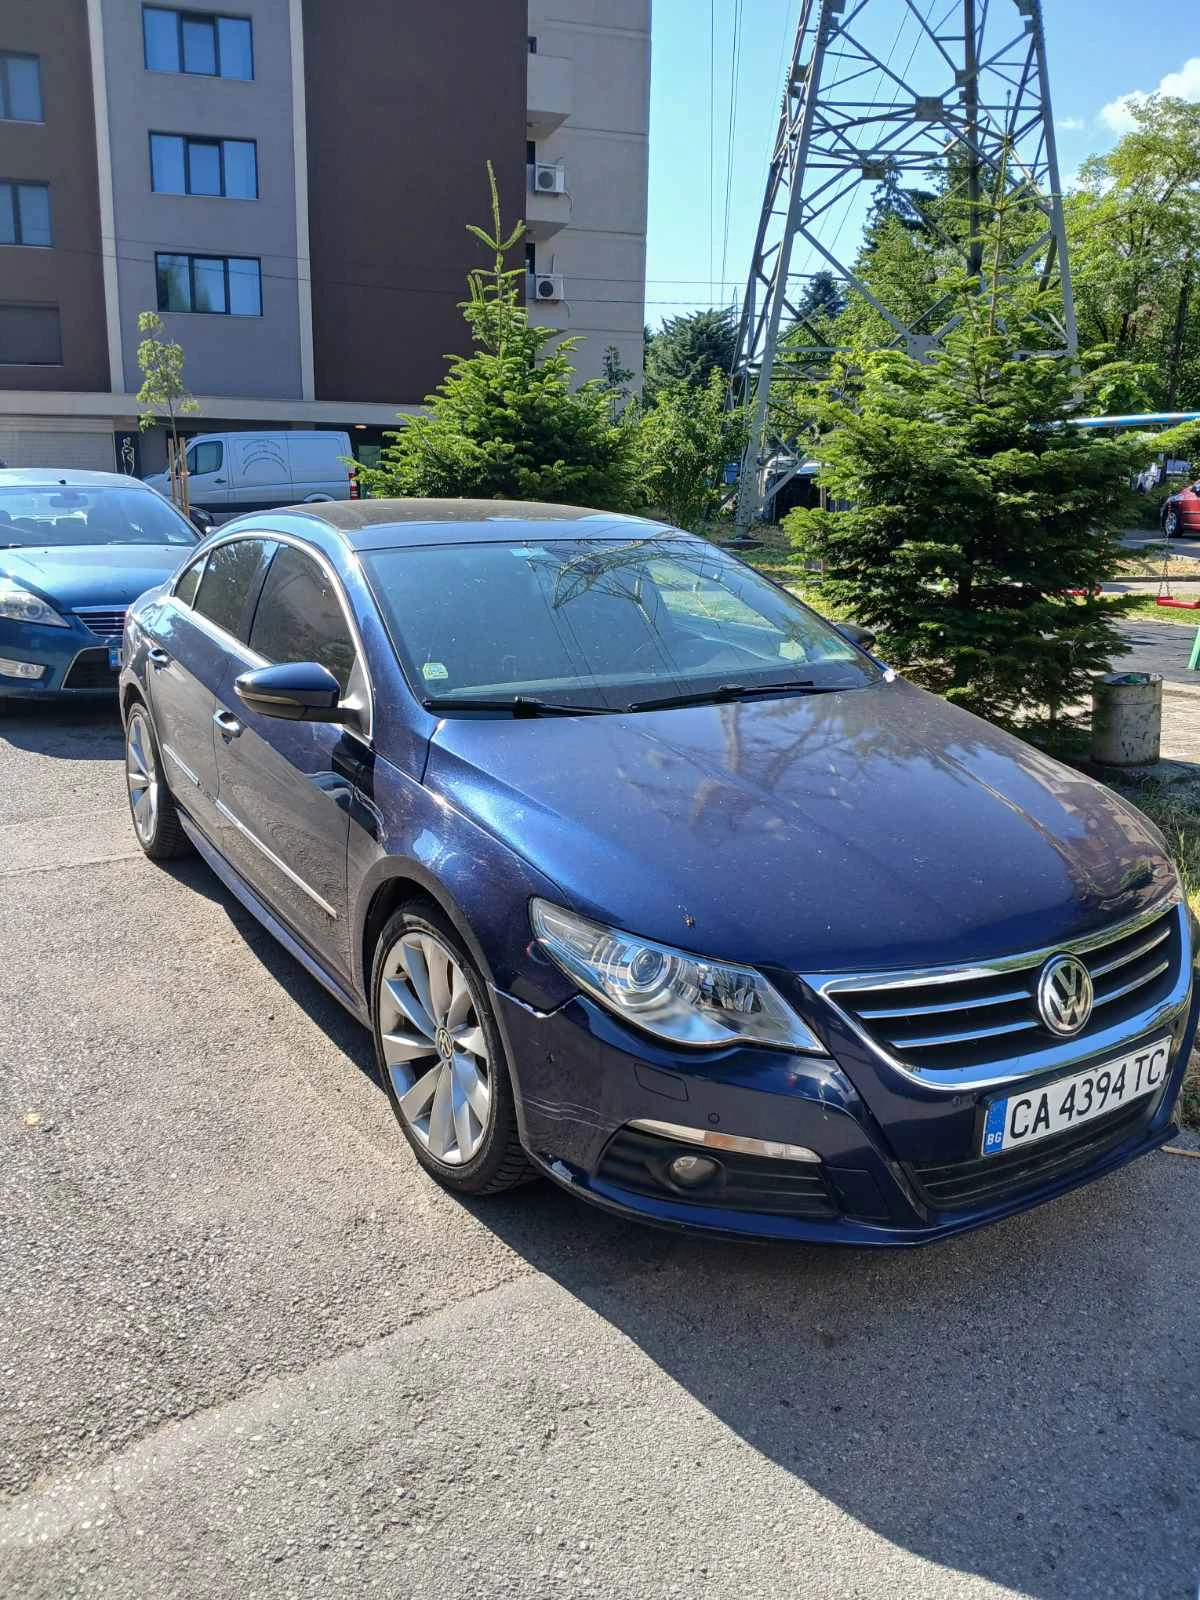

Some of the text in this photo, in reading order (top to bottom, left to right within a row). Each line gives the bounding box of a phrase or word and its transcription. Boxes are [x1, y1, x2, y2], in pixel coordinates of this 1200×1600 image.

[1010, 1048, 1165, 1139] CA 4394 TC
[987, 1131, 1002, 1146] BG
